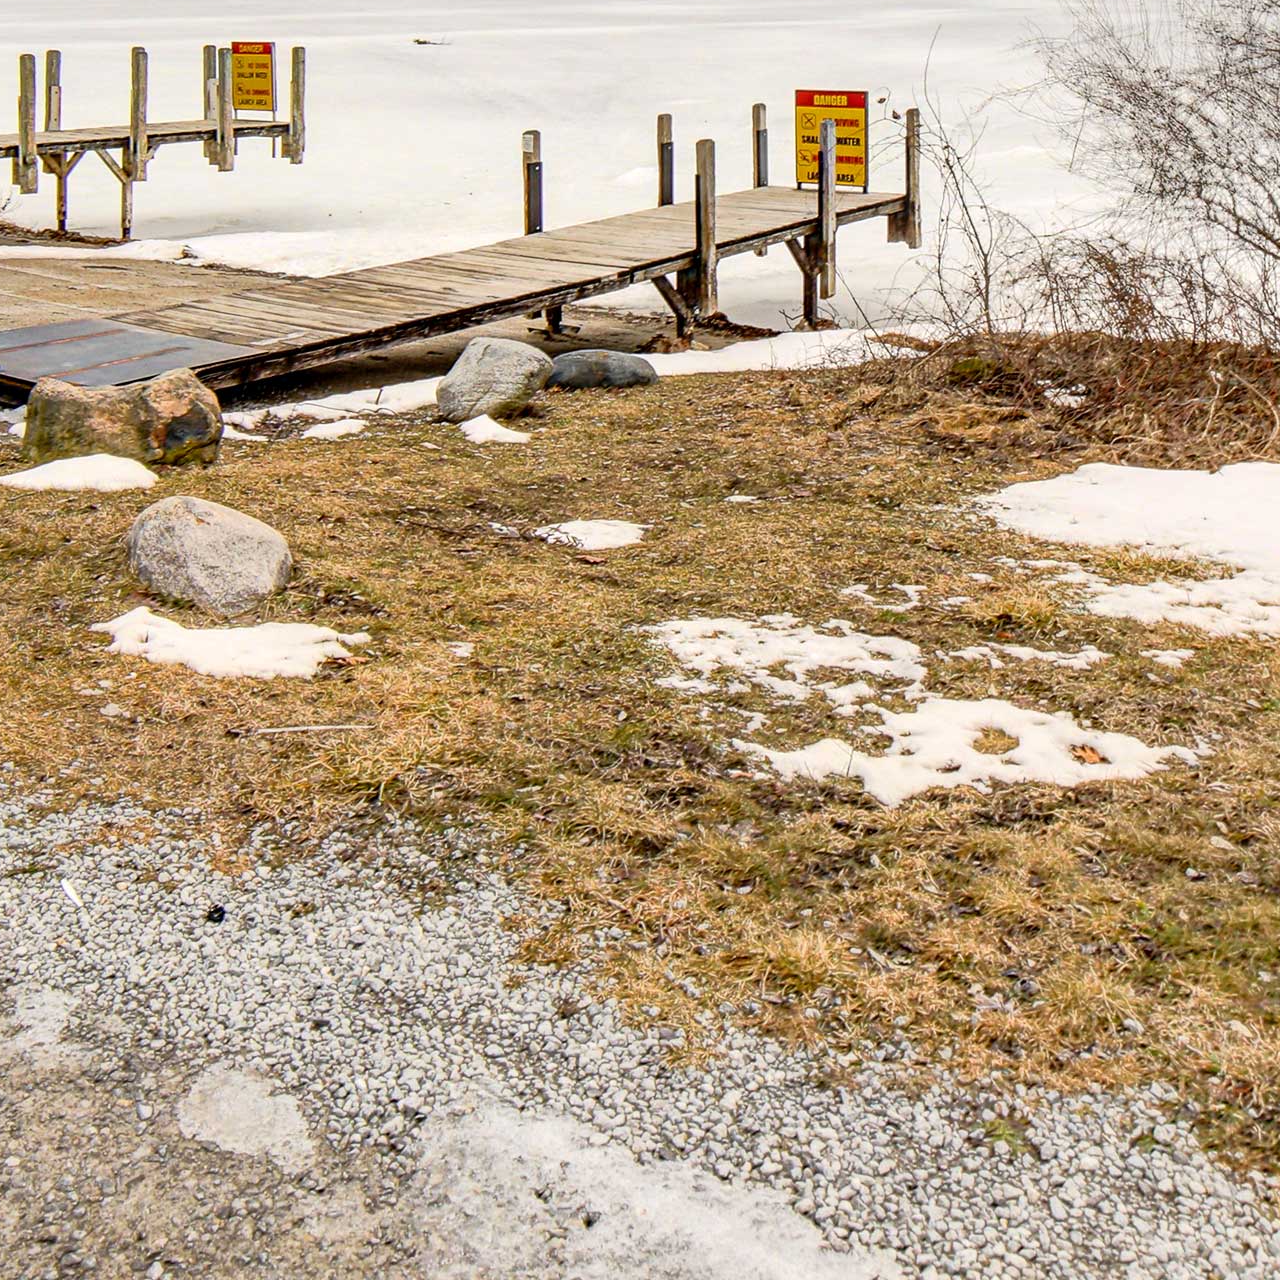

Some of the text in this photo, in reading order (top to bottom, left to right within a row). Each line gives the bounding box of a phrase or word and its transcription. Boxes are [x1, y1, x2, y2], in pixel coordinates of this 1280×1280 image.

[239, 44, 264, 53] DANGER
[814, 95, 848, 106] DANGER
[837, 174, 855, 183] AREA
